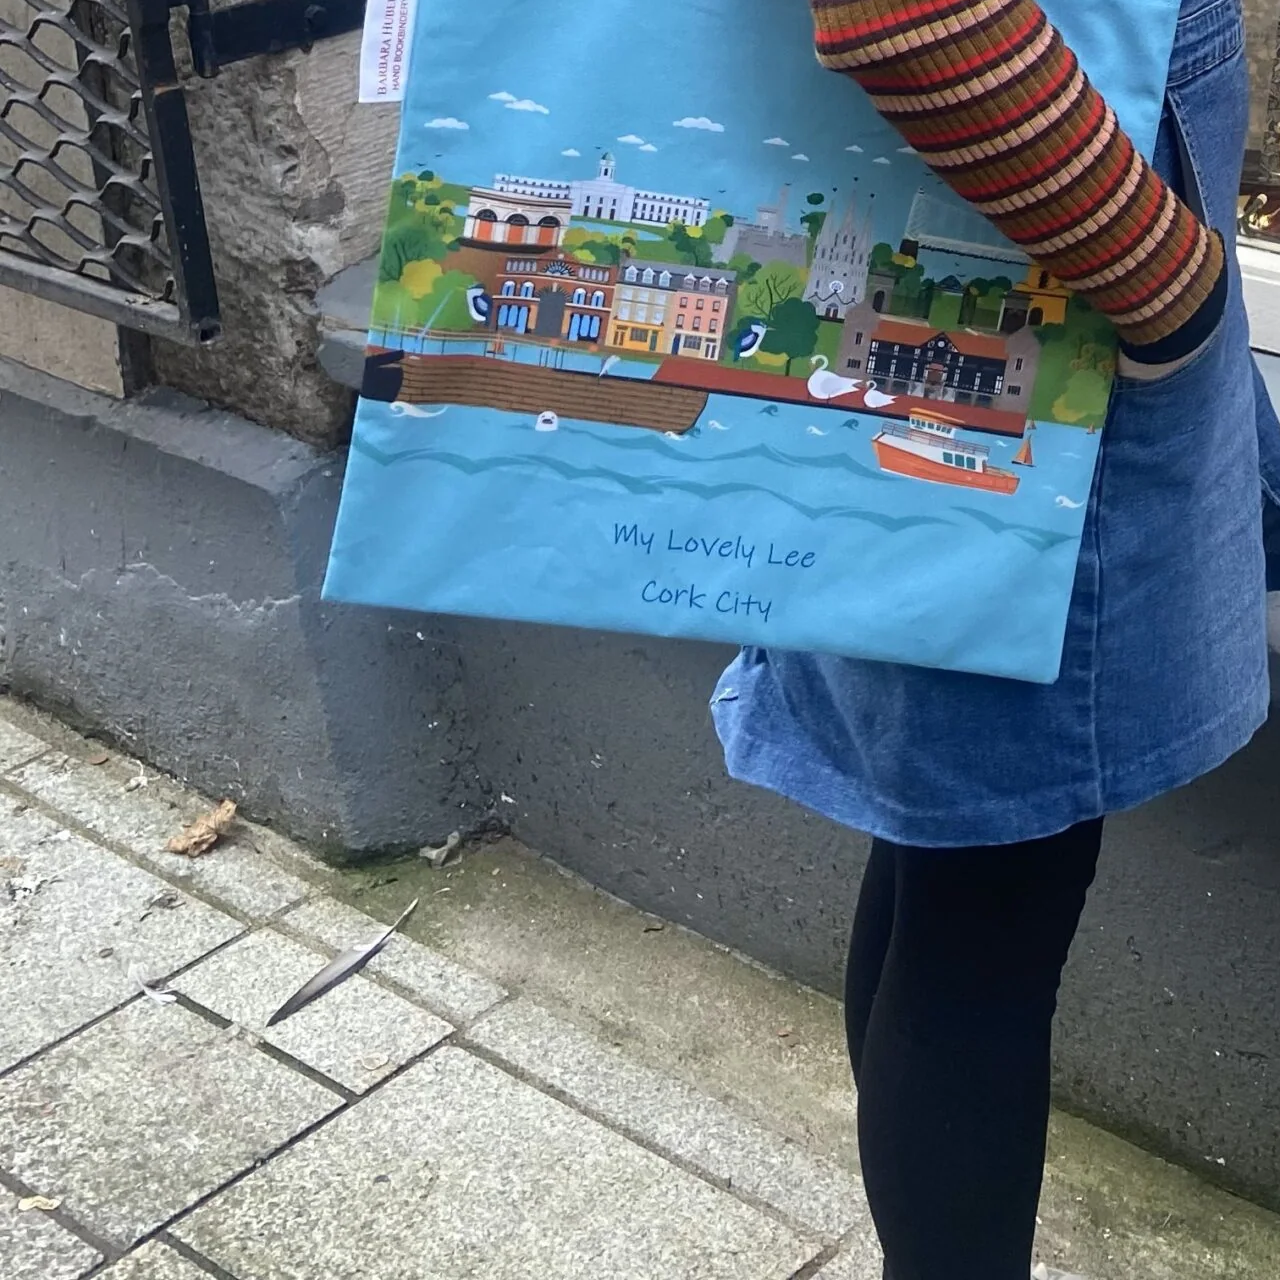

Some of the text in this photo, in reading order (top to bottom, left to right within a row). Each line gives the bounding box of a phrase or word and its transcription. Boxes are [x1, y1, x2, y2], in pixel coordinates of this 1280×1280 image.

[377, 39, 392, 95] BARBARA
[392, 64, 401, 91] HAND
[613, 523, 816, 568] My Lovely Lee
[641, 580, 772, 623] Cork City
